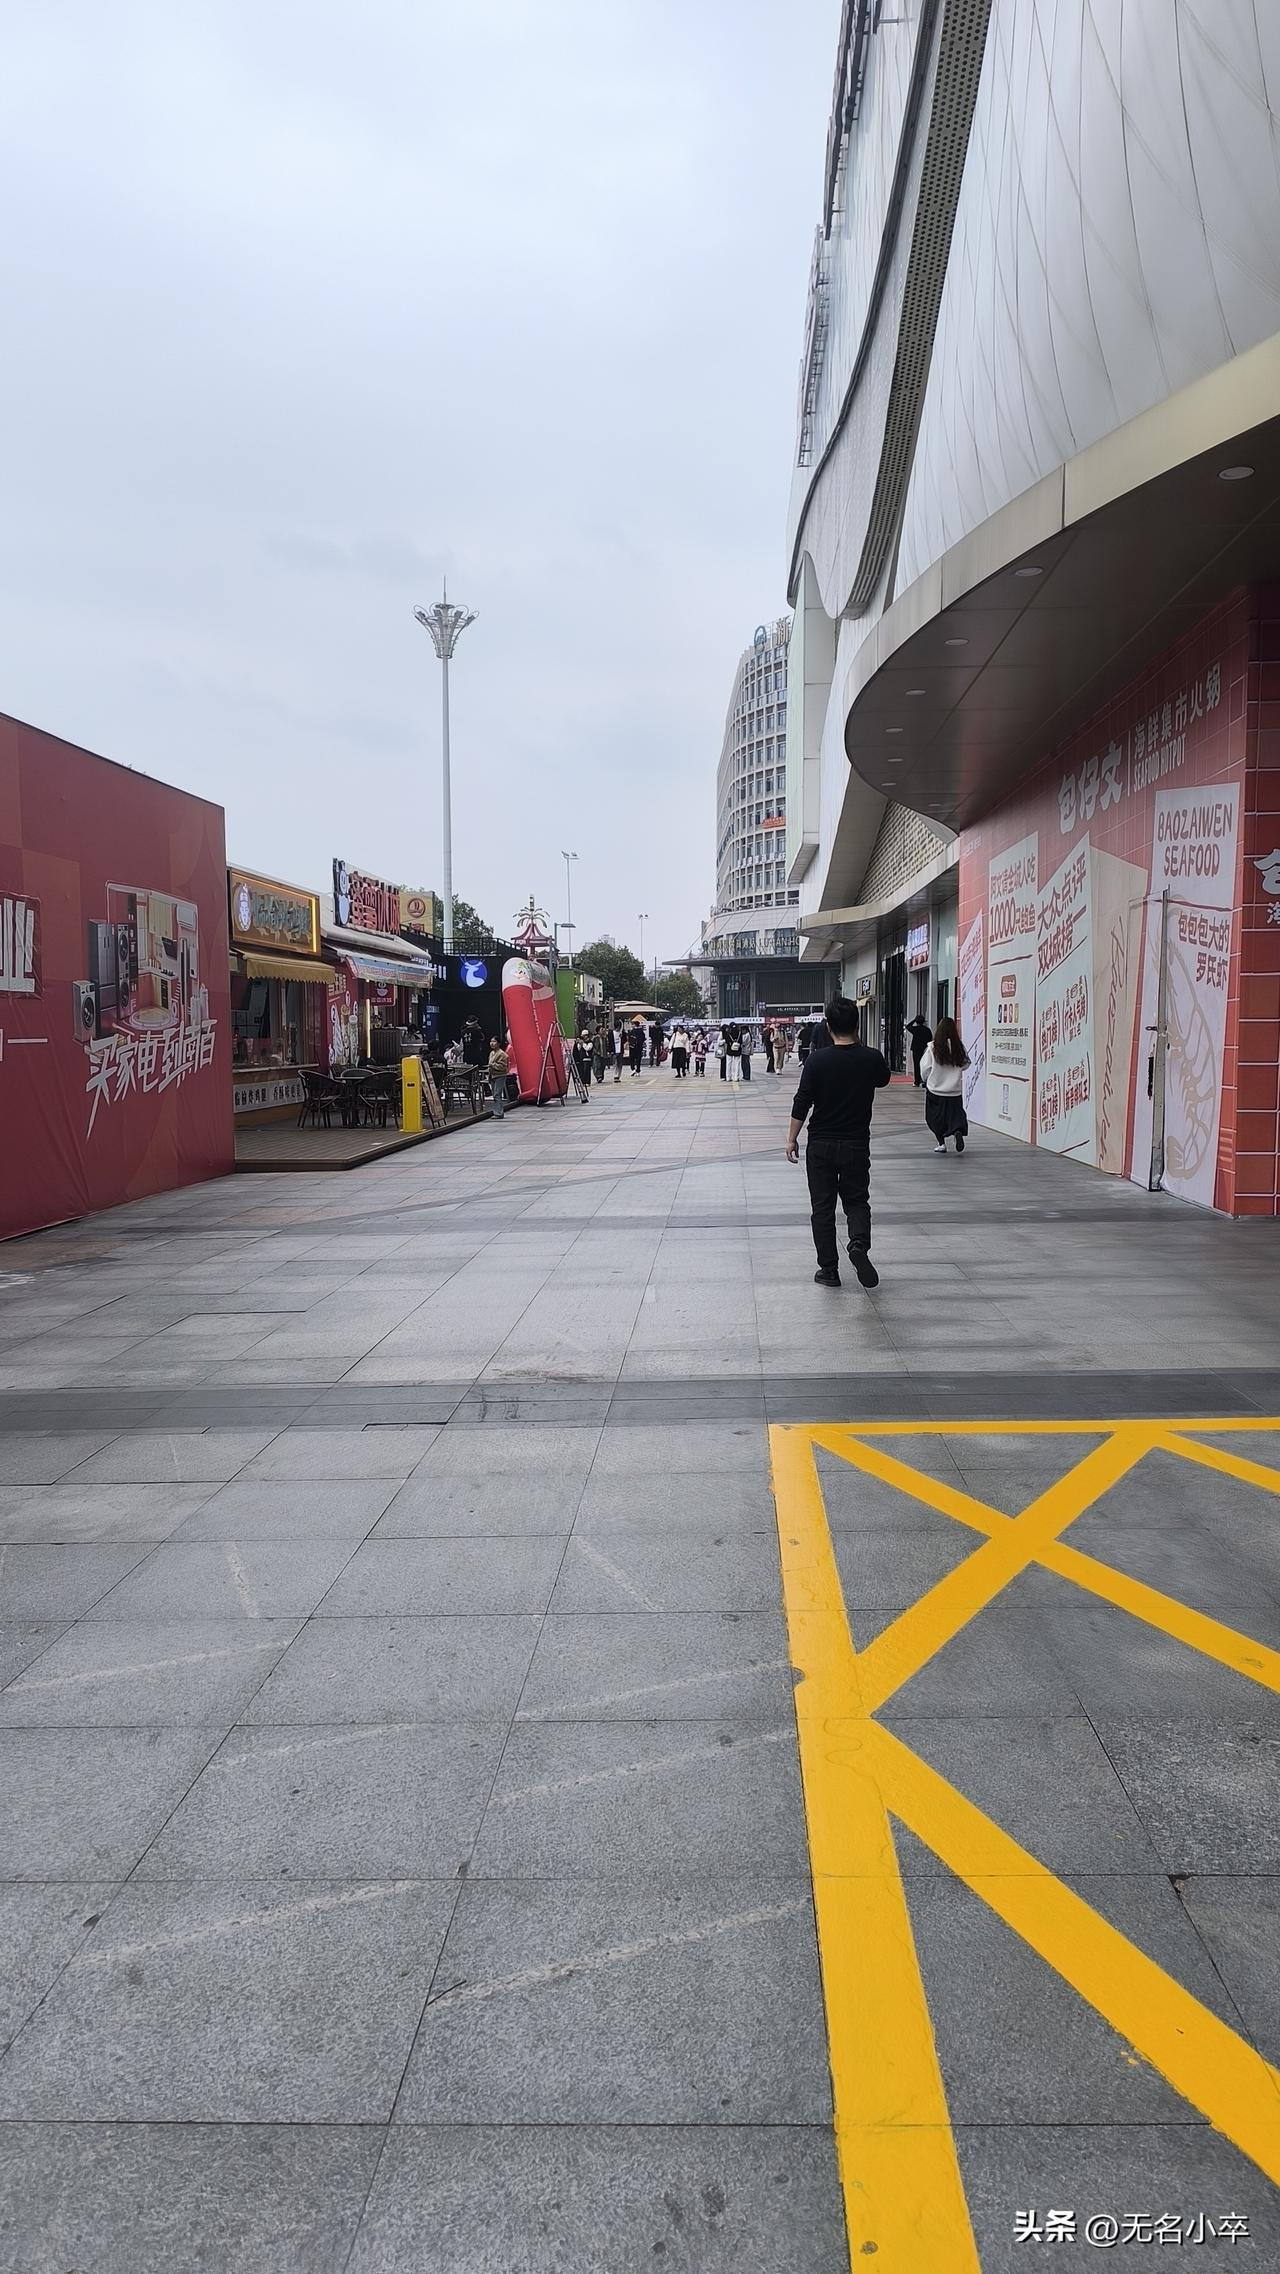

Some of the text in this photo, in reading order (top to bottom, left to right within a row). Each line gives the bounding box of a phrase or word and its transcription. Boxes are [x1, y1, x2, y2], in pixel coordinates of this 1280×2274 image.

[1134, 662, 1221, 760] 海鲜集市火锅
[1057, 740, 1124, 835] 包仔文
[1133, 733, 1187, 793] SEAFOOD HOTPOT
[1157, 803, 1233, 843] BAOZAIWEN
[990, 852, 1036, 901] 阿文请全城人吃
[1163, 843, 1221, 878] SEAFOOD
[348, 870, 401, 937] 蜜雪冰城
[1037, 851, 1087, 940] 大众点评
[1177, 911, 1230, 954] 包包包大的
[1195, 951, 1229, 991] 罗氏虾
[84, 1019, 218, 1139] 买家电到南百
